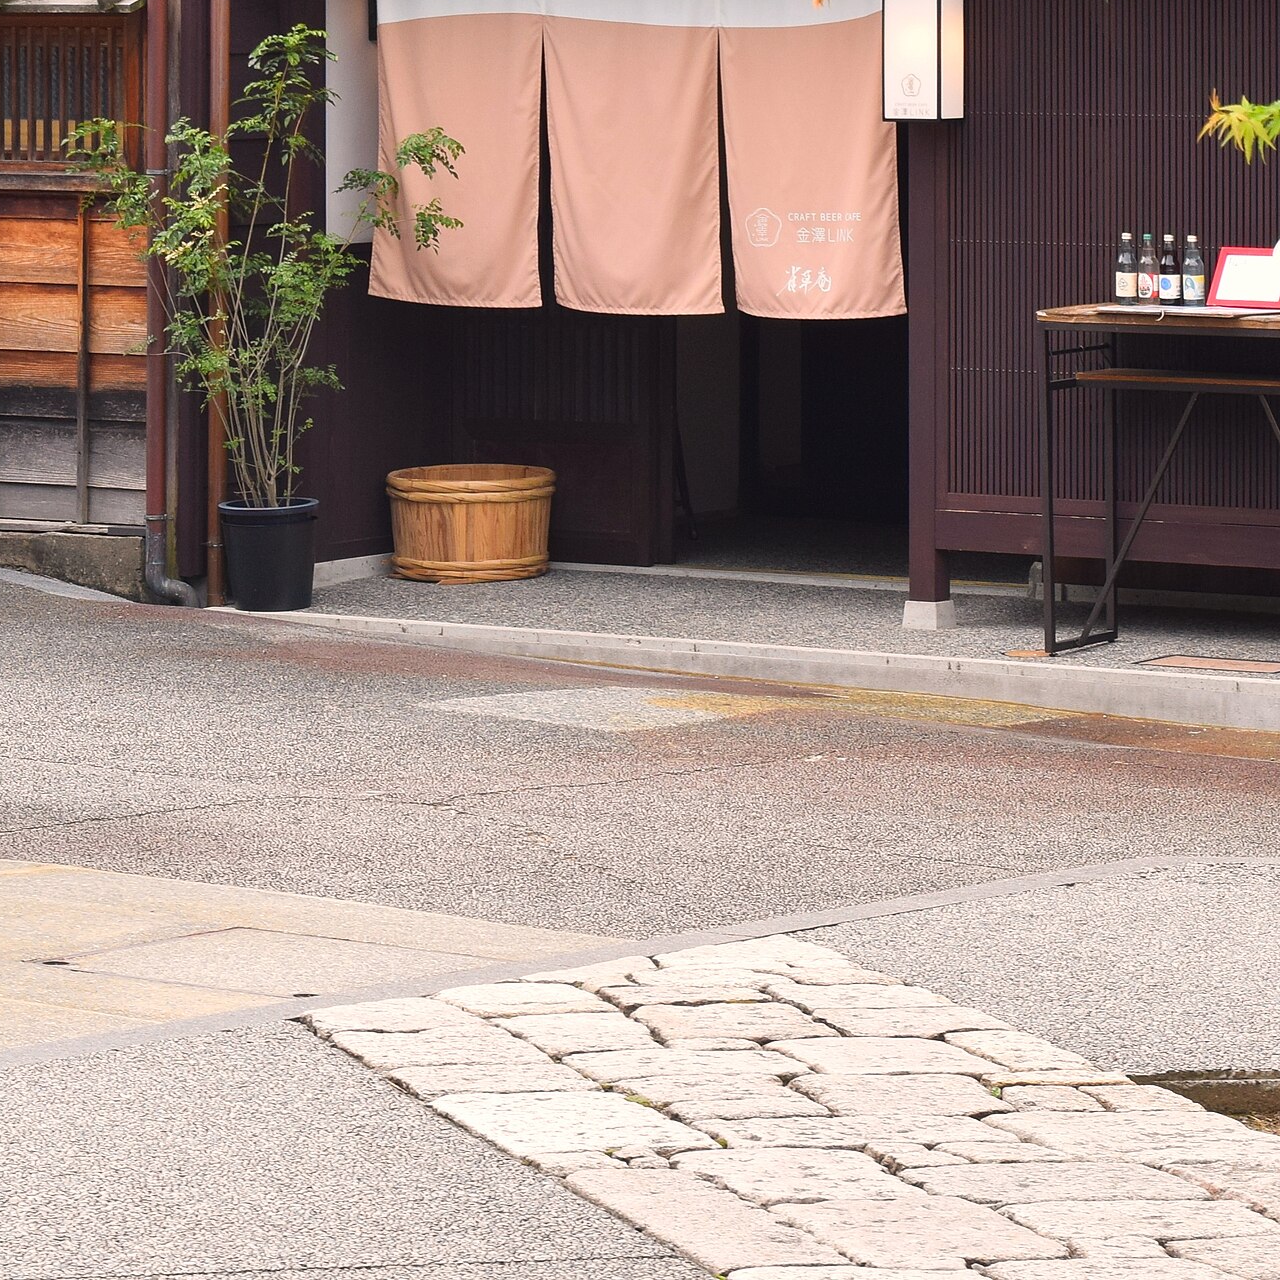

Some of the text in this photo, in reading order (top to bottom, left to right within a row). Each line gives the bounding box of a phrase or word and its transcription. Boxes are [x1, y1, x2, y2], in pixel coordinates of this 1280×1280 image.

[787, 212, 862, 222] CRAFT BEER CAFE
